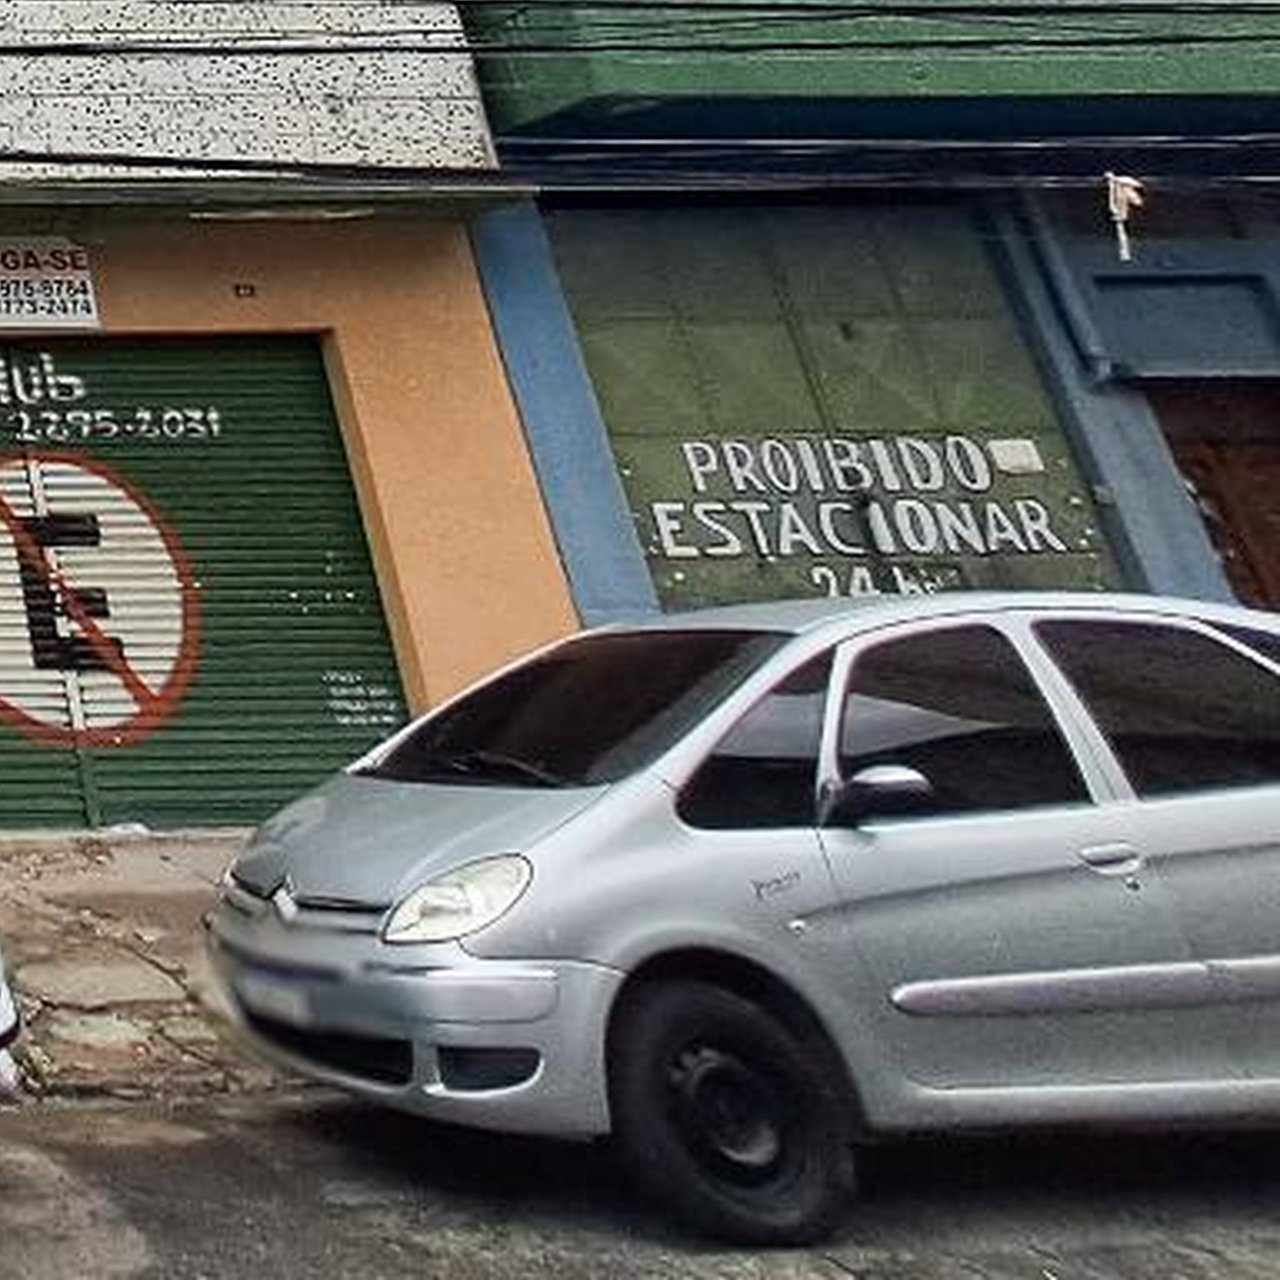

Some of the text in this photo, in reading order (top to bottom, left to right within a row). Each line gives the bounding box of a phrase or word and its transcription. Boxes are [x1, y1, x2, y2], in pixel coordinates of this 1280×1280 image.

[682, 435, 992, 492] PROIBIDO
[650, 499, 1067, 558] ESTACIONAR
[9, 511, 124, 671] E
